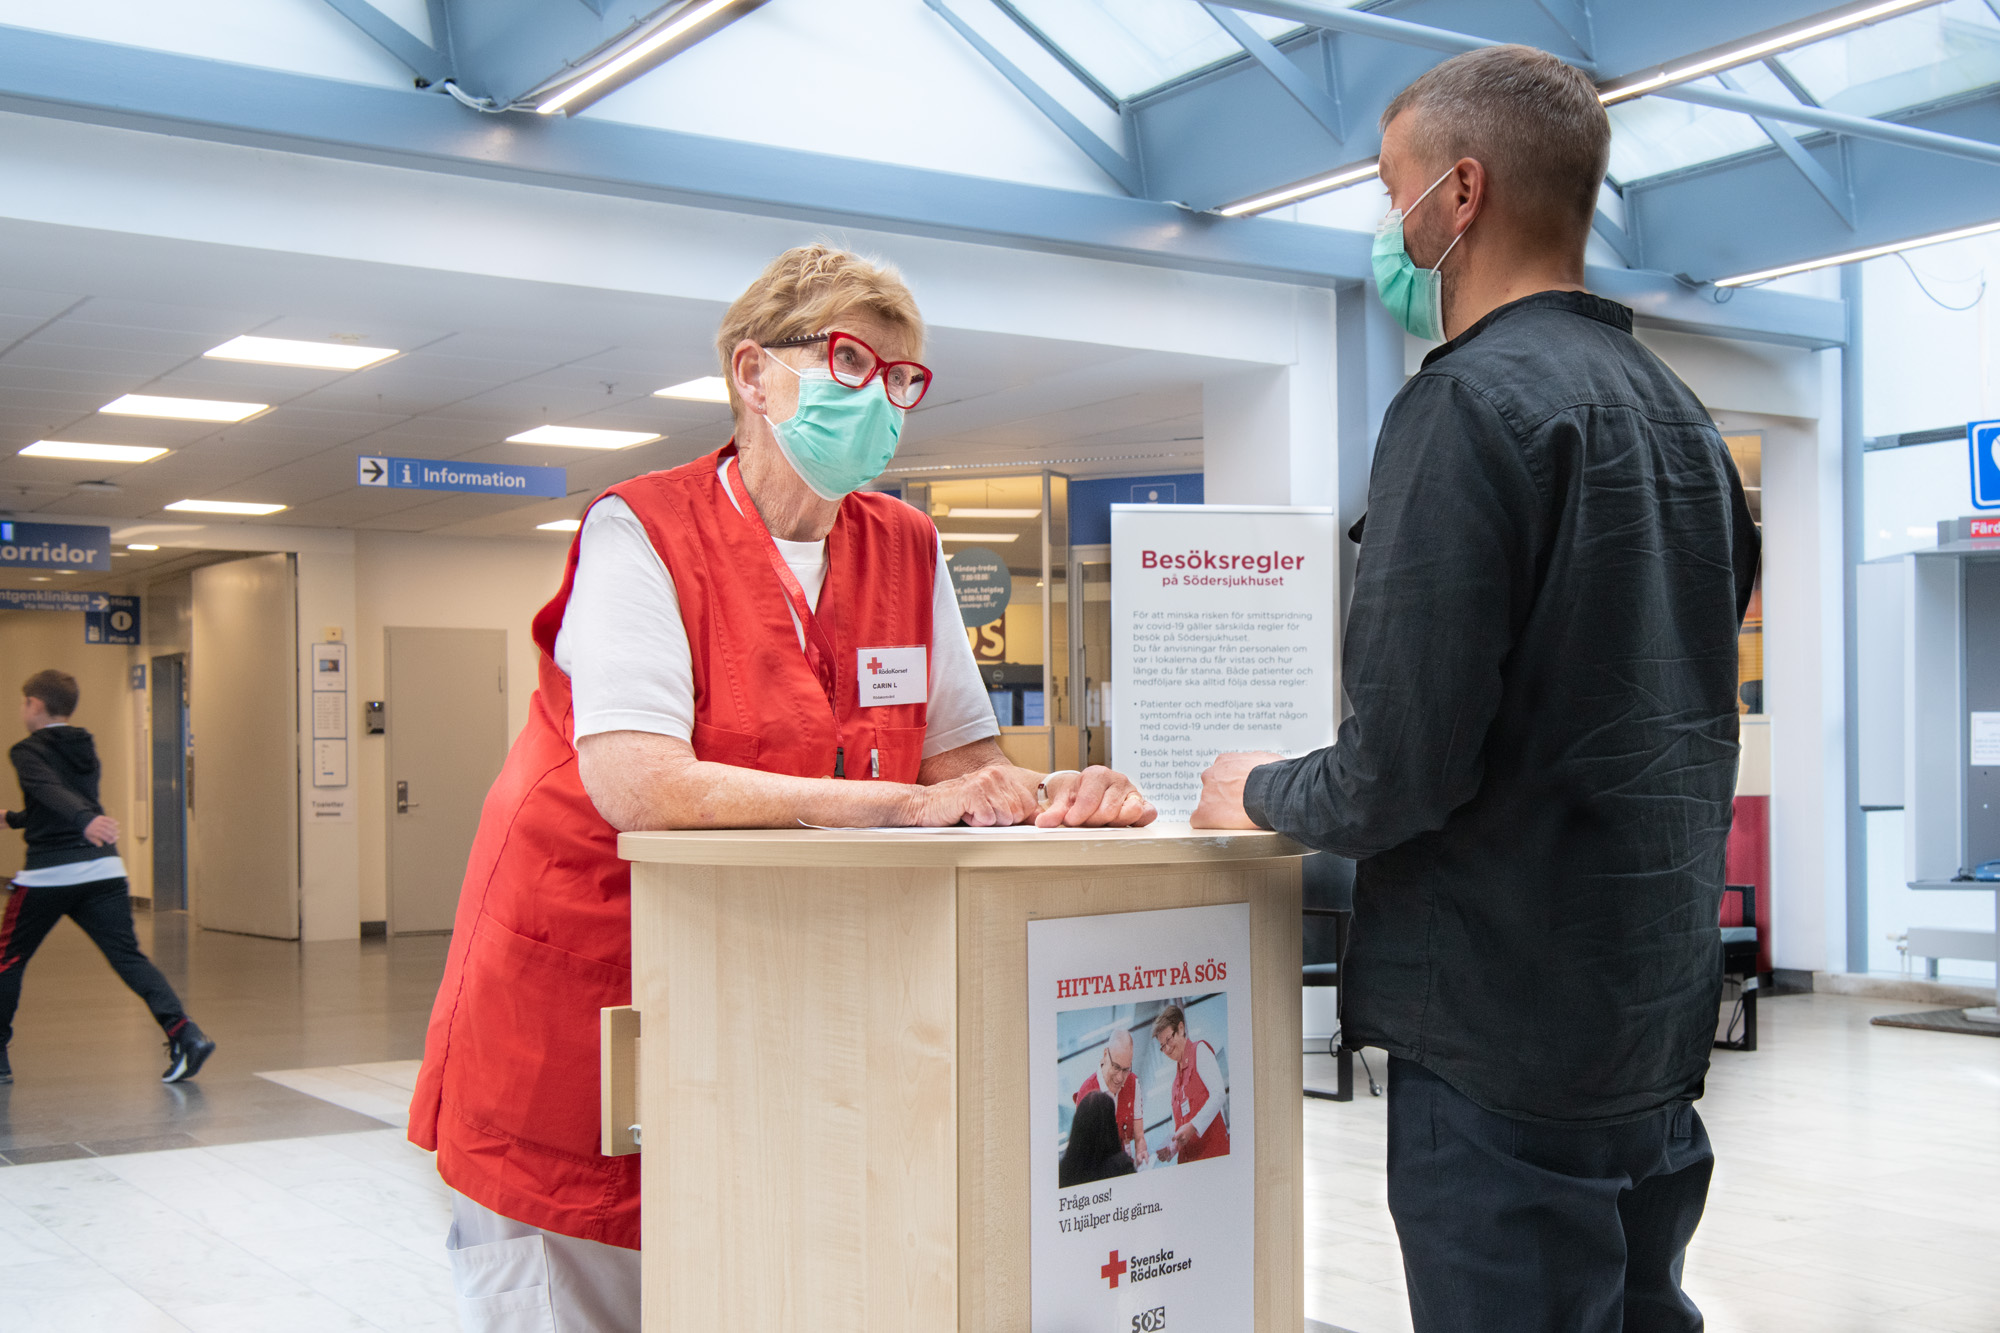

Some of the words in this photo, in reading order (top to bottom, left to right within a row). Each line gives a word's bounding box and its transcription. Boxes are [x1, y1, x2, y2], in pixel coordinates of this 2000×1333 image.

[424, 467, 526, 488] Information
[0, 542, 98, 563] orridor
[1141, 550, 1305, 574] Besöksregler
[1162, 574, 1179, 588] på
[1183, 575, 1285, 588] Södersjukhuset
[0, 591, 89, 603] ntgenkliniken
[1133, 610, 1149, 619] För
[1151, 611, 1164, 619] att
[1167, 611, 1199, 619] minska
[1202, 611, 1229, 619] risken
[1231, 611, 1244, 619] för
[1247, 611, 1313, 621] smittspridning
[1133, 623, 1144, 631] av
[1146, 622, 1184, 631] covid-19
[1187, 622, 1212, 632] gäller
[1215, 622, 1255, 631] särskilda
[1257, 623, 1284, 632] regler
[1287, 622, 1300, 631] för
[1133, 633, 1160, 642] besök
[1163, 633, 1175, 643] på
[1177, 633, 1250, 643] Södersjukhuset.
[1133, 644, 1146, 653] Du
[1149, 644, 1161, 653] får
[1164, 644, 1217, 654] anvisningar
[1219, 644, 1237, 653] från
[1240, 645, 1290, 654] personalen
[1133, 656, 1147, 664] var
[1155, 655, 1197, 664] lokalerna
[1200, 656, 1212, 664] du
[1214, 655, 1227, 664] får
[1229, 656, 1255, 664] vistas
[1258, 656, 1275, 664] och
[1277, 656, 1293, 664] hur
[1133, 666, 1158, 676] länge
[1161, 666, 1173, 675] du
[1175, 666, 1188, 675] får
[1190, 667, 1223, 675] stanna.
[1226, 666, 1250, 675] Både
[1252, 667, 1294, 676] patienter
[1296, 667, 1313, 675] och
[872, 682, 892, 690] CARIN
[1133, 678, 1182, 688] medföljare
[1184, 678, 1200, 686] ska
[1202, 678, 1225, 686] alltid
[1228, 678, 1248, 688] följa
[1250, 678, 1276, 686] dessa
[1279, 678, 1308, 688] regler:
[1140, 700, 1182, 708] Patienter
[1184, 700, 1202, 708] och
[1204, 701, 1253, 709] medföljare
[1140, 711, 1192, 720] symtomfria
[1194, 711, 1212, 719] och
[1214, 711, 1232, 719] inte
[1234, 711, 1246, 719] ha
[1248, 711, 1276, 719] träffat
[1279, 711, 1308, 721] någon
[1140, 723, 1160, 731] med
[1163, 722, 1201, 730] covid-19
[1203, 722, 1229, 730] under
[1247, 723, 1282, 731] senaste
[1152, 734, 1192, 742] dagarna.
[1140, 748, 1168, 756] Besök
[1171, 748, 1193, 756] helst
[1140, 760, 1152, 768] du
[1154, 760, 1169, 768] har
[1172, 760, 1201, 768] behov
[1174, 771, 1194, 780] följa
[1056, 975, 1116, 999] HITTA
[1118, 966, 1167, 992] RÄTT
[1169, 961, 1192, 986] PÅ
[1195, 958, 1227, 983] SÖS
[1058, 1194, 1091, 1212] Fråga
[1092, 1187, 1112, 1205] oss!
[1059, 1218, 1072, 1233] Vi
[1073, 1213, 1111, 1233] hjälper
[1112, 1207, 1130, 1222] dig
[1130, 1202, 1163, 1220] gärna.
[1130, 1248, 1174, 1269] Svenska
[1131, 1305, 1166, 1333] SÖS
